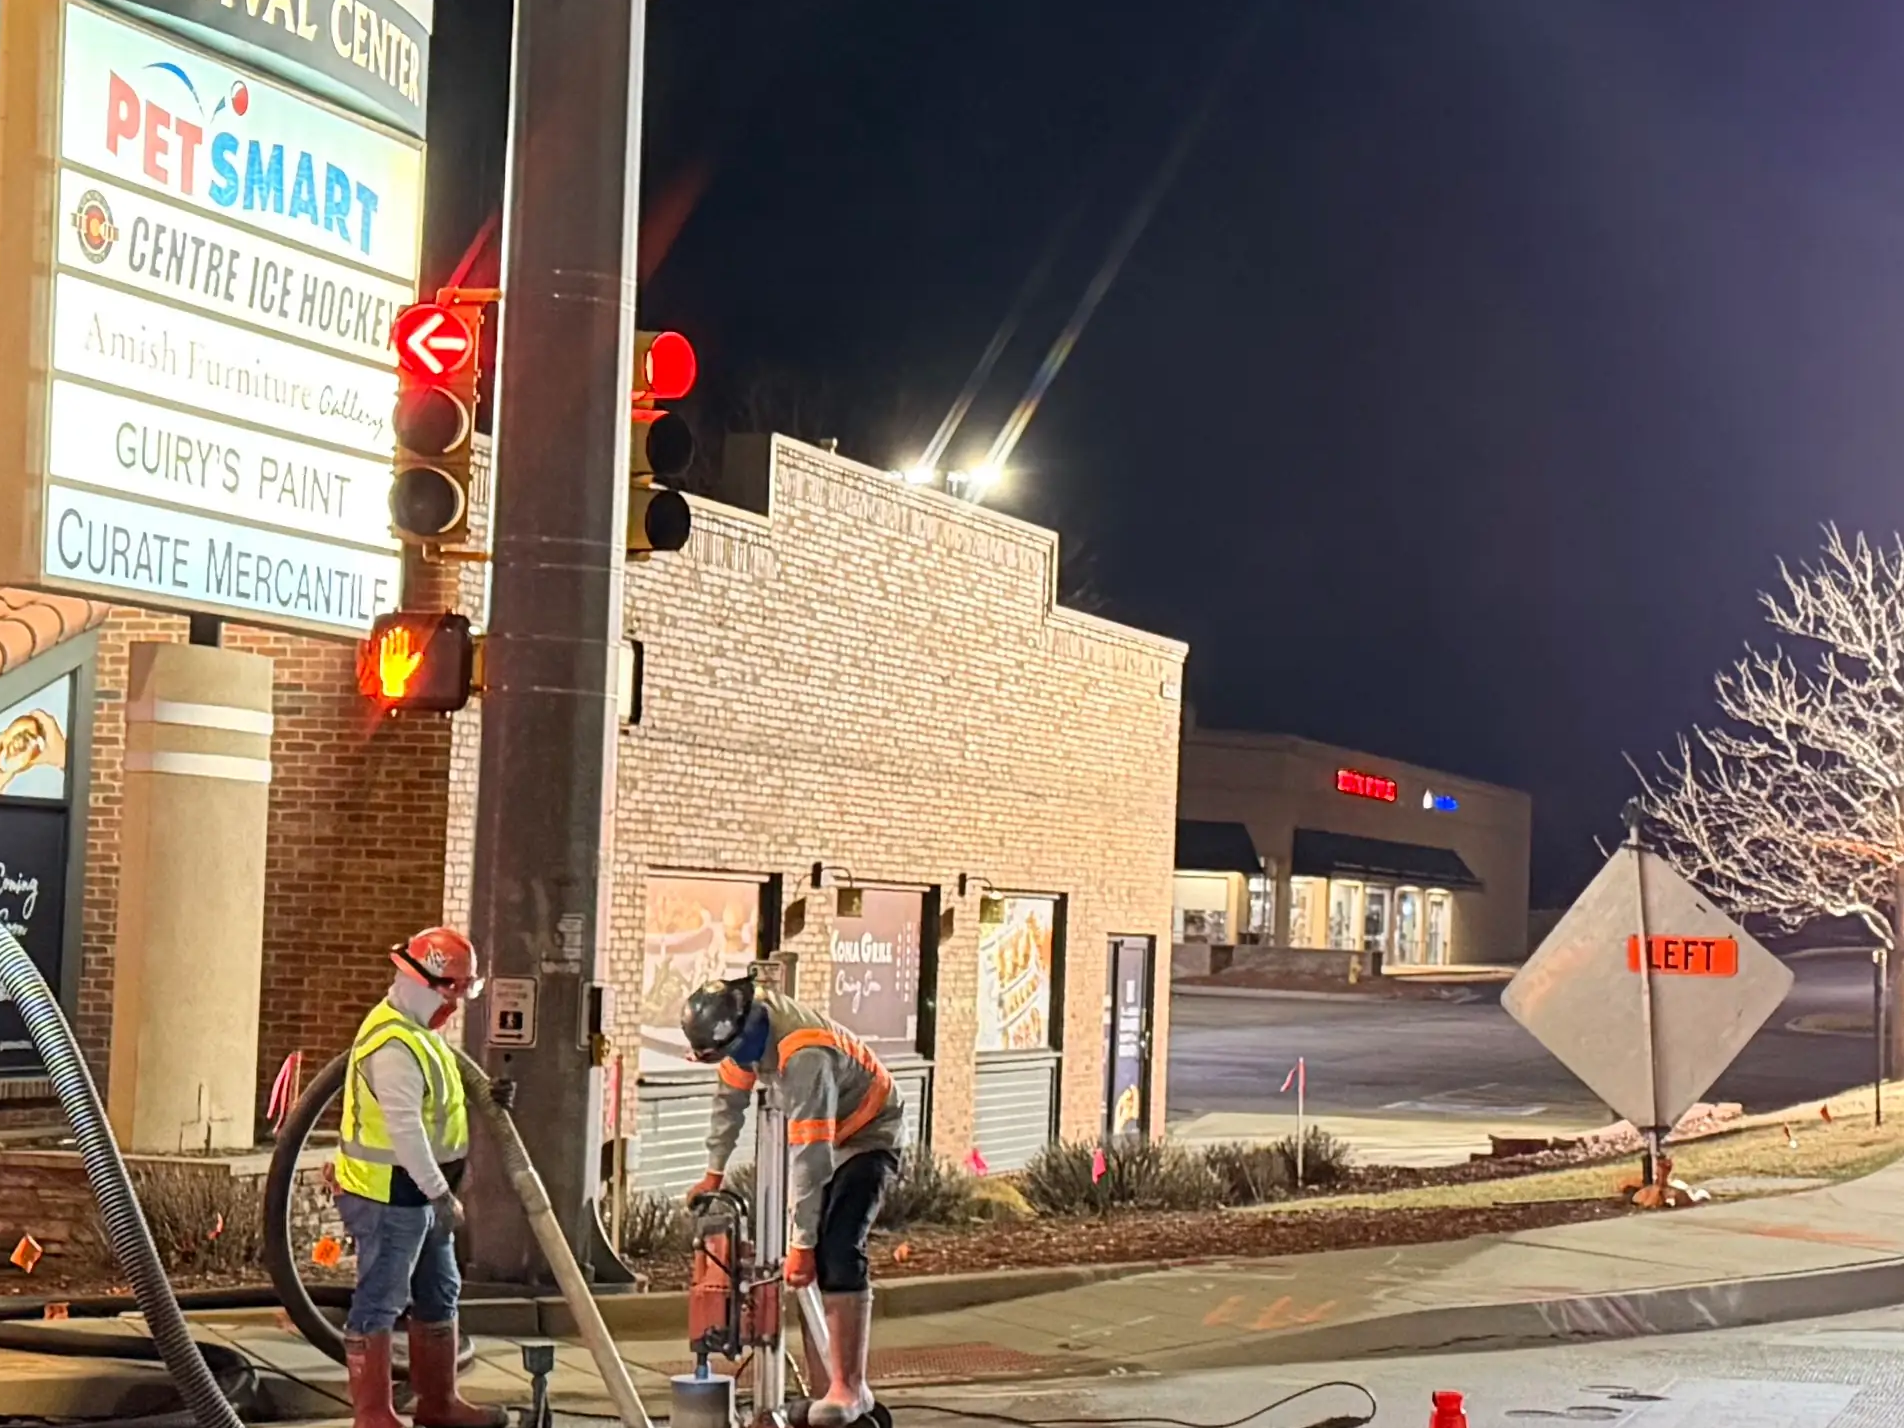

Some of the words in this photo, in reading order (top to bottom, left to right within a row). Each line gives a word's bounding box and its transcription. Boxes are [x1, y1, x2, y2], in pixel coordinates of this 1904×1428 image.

[105, 68, 380, 257] PETSMART
[128, 216, 241, 303] CENTRE
[247, 256, 293, 320] ICE
[83, 312, 177, 376] Amish
[188, 340, 313, 412] Furniture
[319, 384, 384, 442] Gallery
[116, 421, 241, 495] GUIRY'S
[258, 456, 351, 519] PAINT
[57, 507, 190, 589] CURATE
[205, 537, 389, 621] MERCANTILE
[1647, 940, 1715, 970] LEFT
